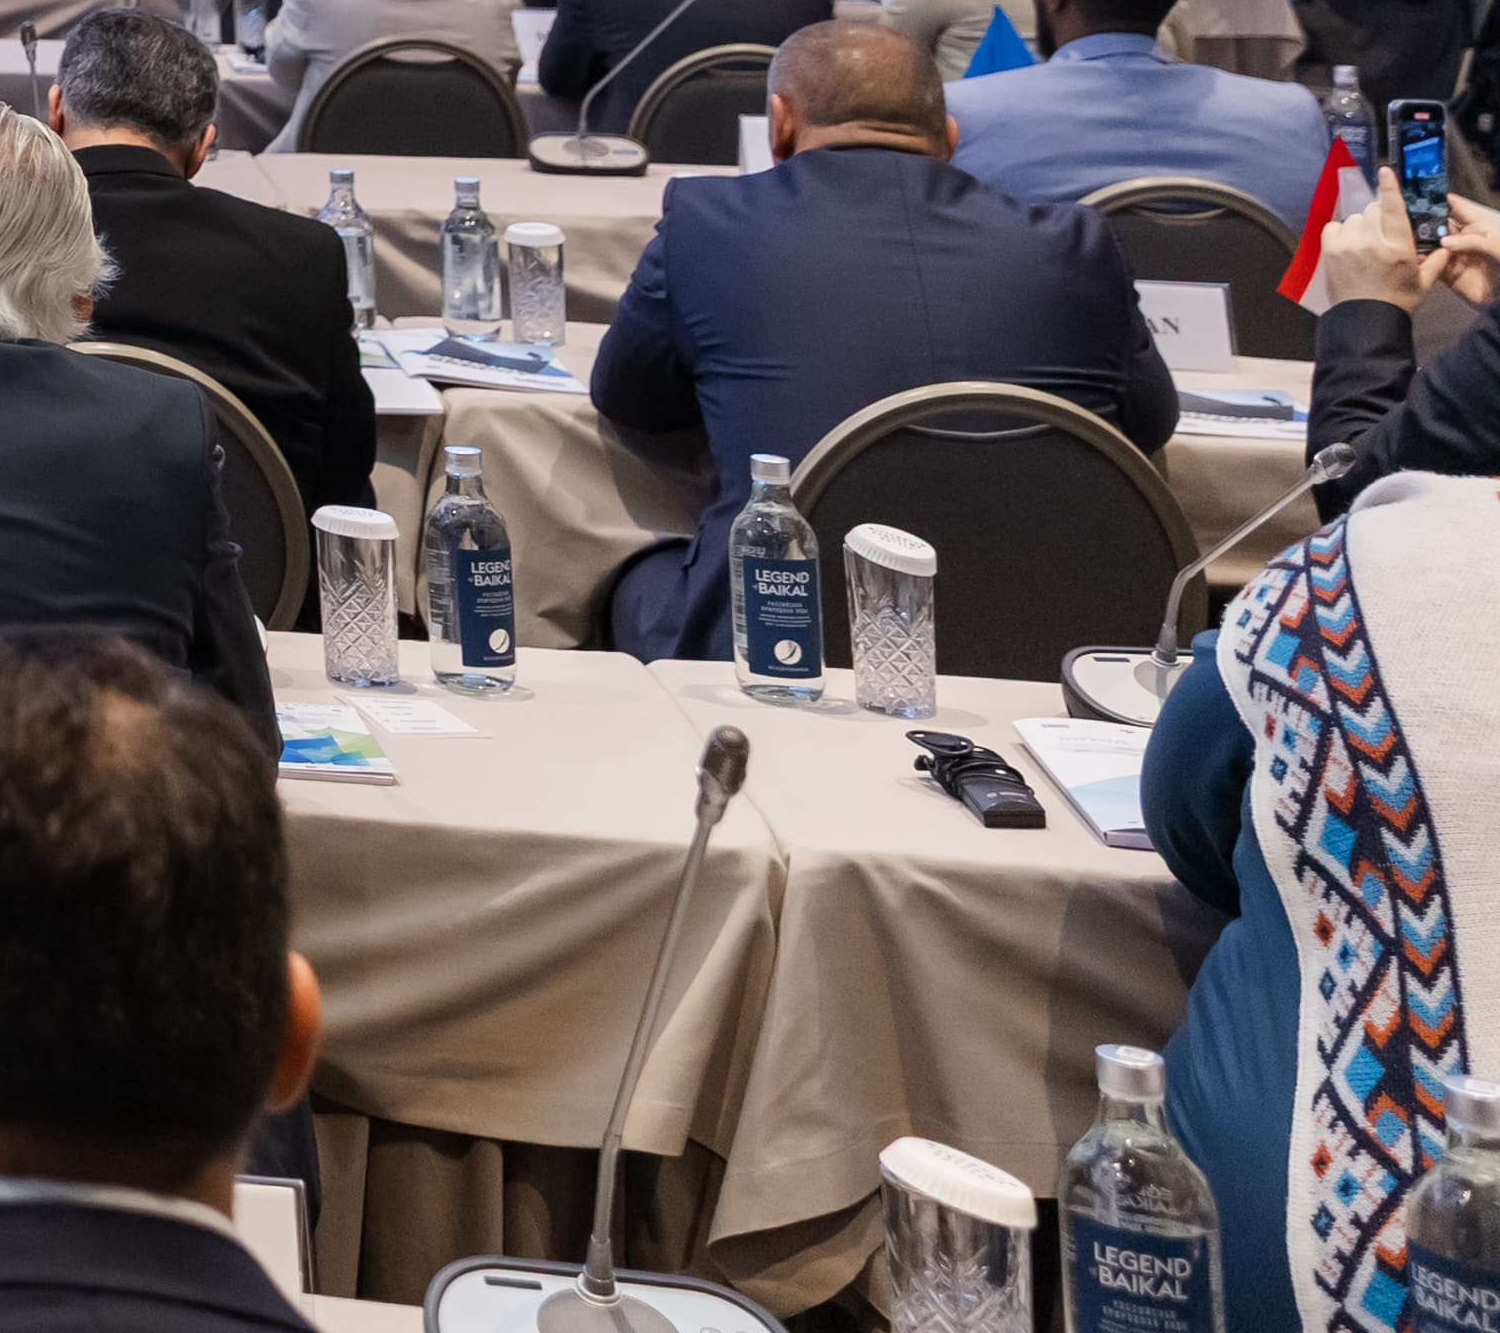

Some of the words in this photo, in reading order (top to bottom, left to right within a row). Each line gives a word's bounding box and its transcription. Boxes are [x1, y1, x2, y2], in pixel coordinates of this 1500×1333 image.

[1146, 317, 1181, 335] AN
[755, 569, 810, 585] LEGEND
[757, 582, 809, 597] BAIKAL
[1093, 1241, 1192, 1278] LEGEND
[1098, 1265, 1189, 1301] BAIKAL
[1411, 1261, 1500, 1311] LEGEND
[1414, 1284, 1500, 1333] BAIKAL
